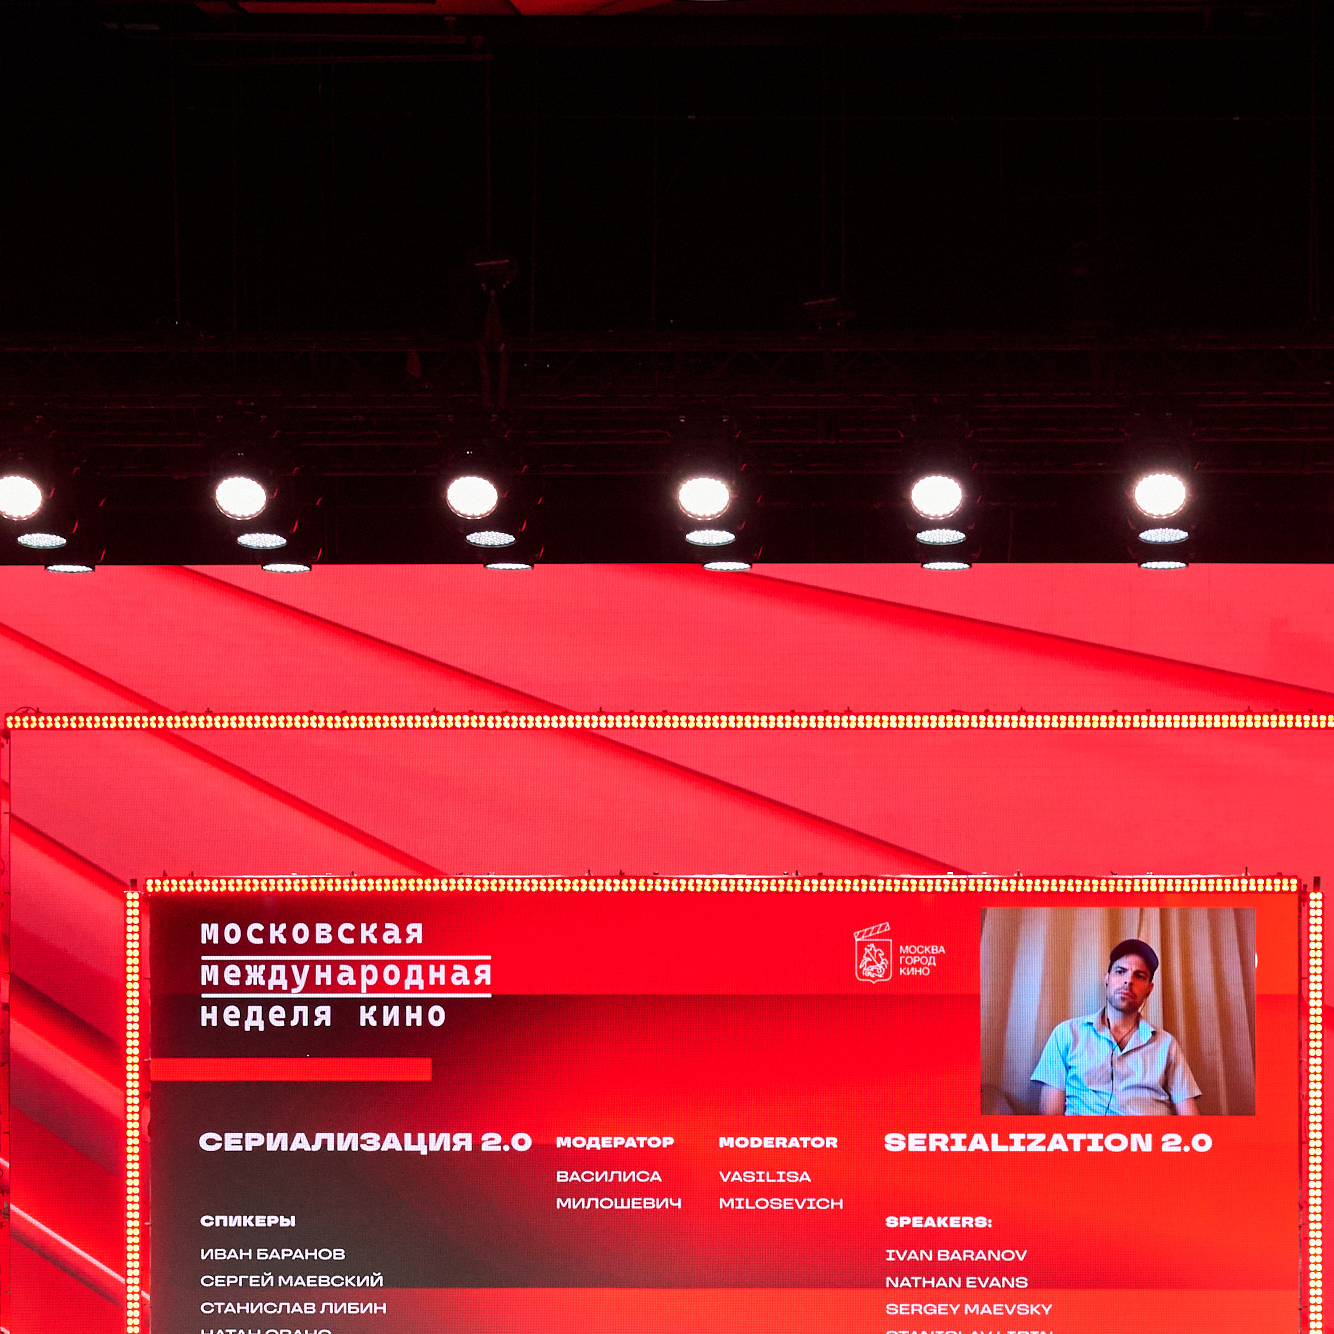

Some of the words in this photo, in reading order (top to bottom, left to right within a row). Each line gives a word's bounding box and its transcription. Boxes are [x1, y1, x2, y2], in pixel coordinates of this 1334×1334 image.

[200, 922, 423, 945] московская
[899, 944, 946, 955] МОСКВА
[899, 955, 937, 967] ГОРОД
[899, 966, 931, 976] КИНО
[200, 963, 491, 993] международная
[200, 1004, 331, 1032] неделя
[359, 1004, 446, 1027] кино
[198, 1131, 473, 1156] СЕРИАЛИЗАЦИЯ
[480, 1132, 533, 1152] 2.0
[556, 1136, 675, 1151] МОДЕРАТОР
[718, 1136, 838, 1149] MODERATOR
[884, 1132, 1153, 1153] SERIALIZATION
[1161, 1132, 1213, 1153] 2.0
[556, 1170, 663, 1183] ВАСИЛИСА
[718, 1170, 812, 1183] VASILISA
[556, 1197, 682, 1210] МИЛОШЕВИЧ
[719, 1197, 844, 1210] MILOSEVICH
[200, 1214, 296, 1228] СПИКЕРЫ
[885, 1215, 993, 1228] SPEAKERS:
[200, 1248, 253, 1260] ИВАН
[256, 1248, 346, 1261] БАРАНОВ
[885, 1249, 933, 1262] IVAN
[937, 1249, 1028, 1262] BARANOV
[200, 1271, 274, 1287] СЕРГЕЙ
[278, 1271, 384, 1288] МАЕВСКИЙ
[885, 1276, 962, 1288] NATHAN
[965, 1276, 1029, 1289] EVANS
[200, 1301, 317, 1314] СТАНИСЛАВ
[319, 1302, 387, 1315] ЛИБИН
[885, 1303, 961, 1316] SERGEY
[964, 1303, 1053, 1316] MAEVSKY
